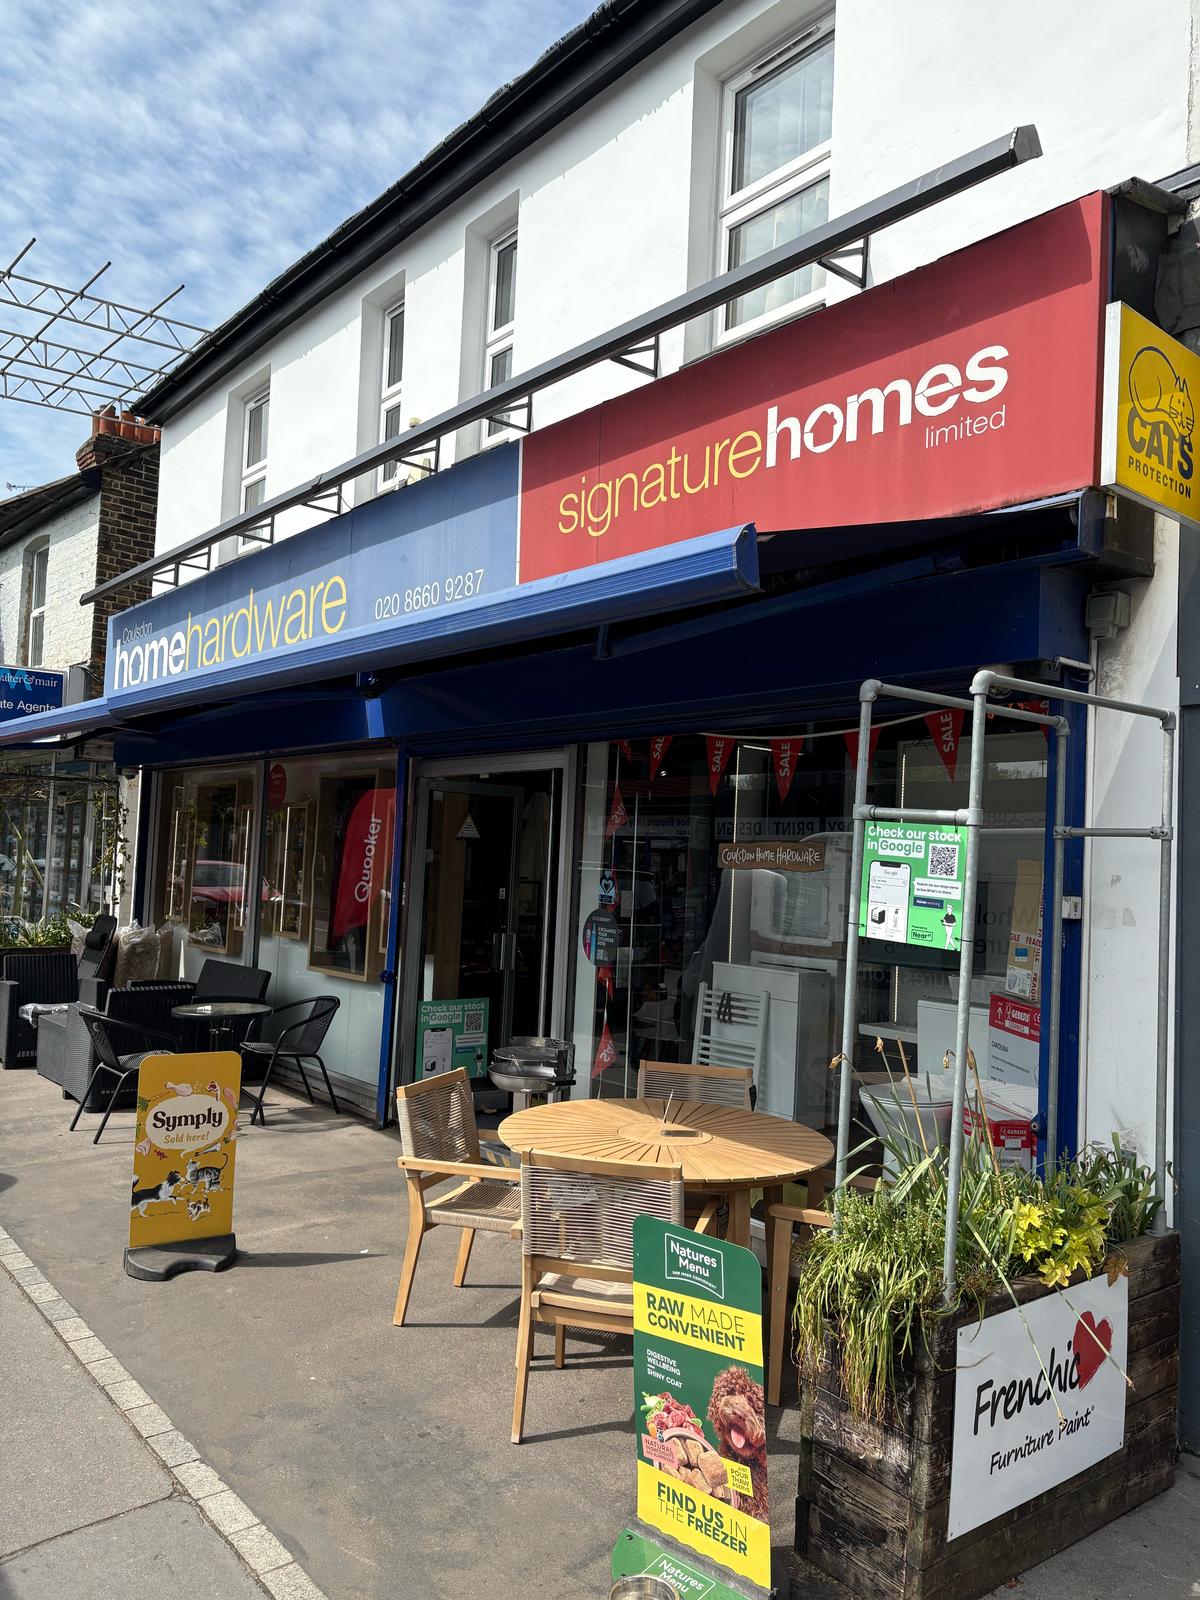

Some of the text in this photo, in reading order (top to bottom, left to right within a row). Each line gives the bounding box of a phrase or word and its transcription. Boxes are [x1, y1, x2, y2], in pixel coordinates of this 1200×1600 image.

[925, 404, 1006, 449] limited
[1127, 405, 1193, 480] CATS
[1128, 455, 1192, 499] PROTECTION
[375, 569, 484, 620] 020 8660 9287
[123, 621, 152, 643] Coulsdon
[0, 672, 23, 684] alter
[35, 677, 60, 688] mair
[940, 712, 955, 753] SALE
[653, 735, 665, 759] SAL
[711, 739, 725, 772] SALE
[779, 741, 792, 777] SALE
[867, 838, 923, 856] in Google
[868, 825, 962, 843] Check our stock
[354, 817, 382, 902] Quooker
[421, 1001, 486, 1013] Check our stock
[421, 1012, 461, 1023] in Google
[152, 1107, 223, 1132] Symply
[163, 1131, 210, 1144] Sold here!
[670, 1240, 717, 1268] Natures
[679, 1257, 710, 1277] Menu
[646, 1292, 745, 1335] RAW MADE
[647, 1312, 745, 1351] CONVENIENT
[646, 1348, 677, 1367] DIGESTIVE
[646, 1355, 681, 1376] WELLBEING
[646, 1368, 682, 1389] SHINY COAT
[973, 1340, 1081, 1436] Frenchic
[990, 1428, 1054, 1475] Furniture
[730, 1468, 749, 1480] POUR
[657, 1481, 747, 1542] FIND US IN
[658, 1497, 748, 1556] THE FREEZER
[659, 1559, 704, 1590] Natures
[659, 1570, 689, 1594] Menu
